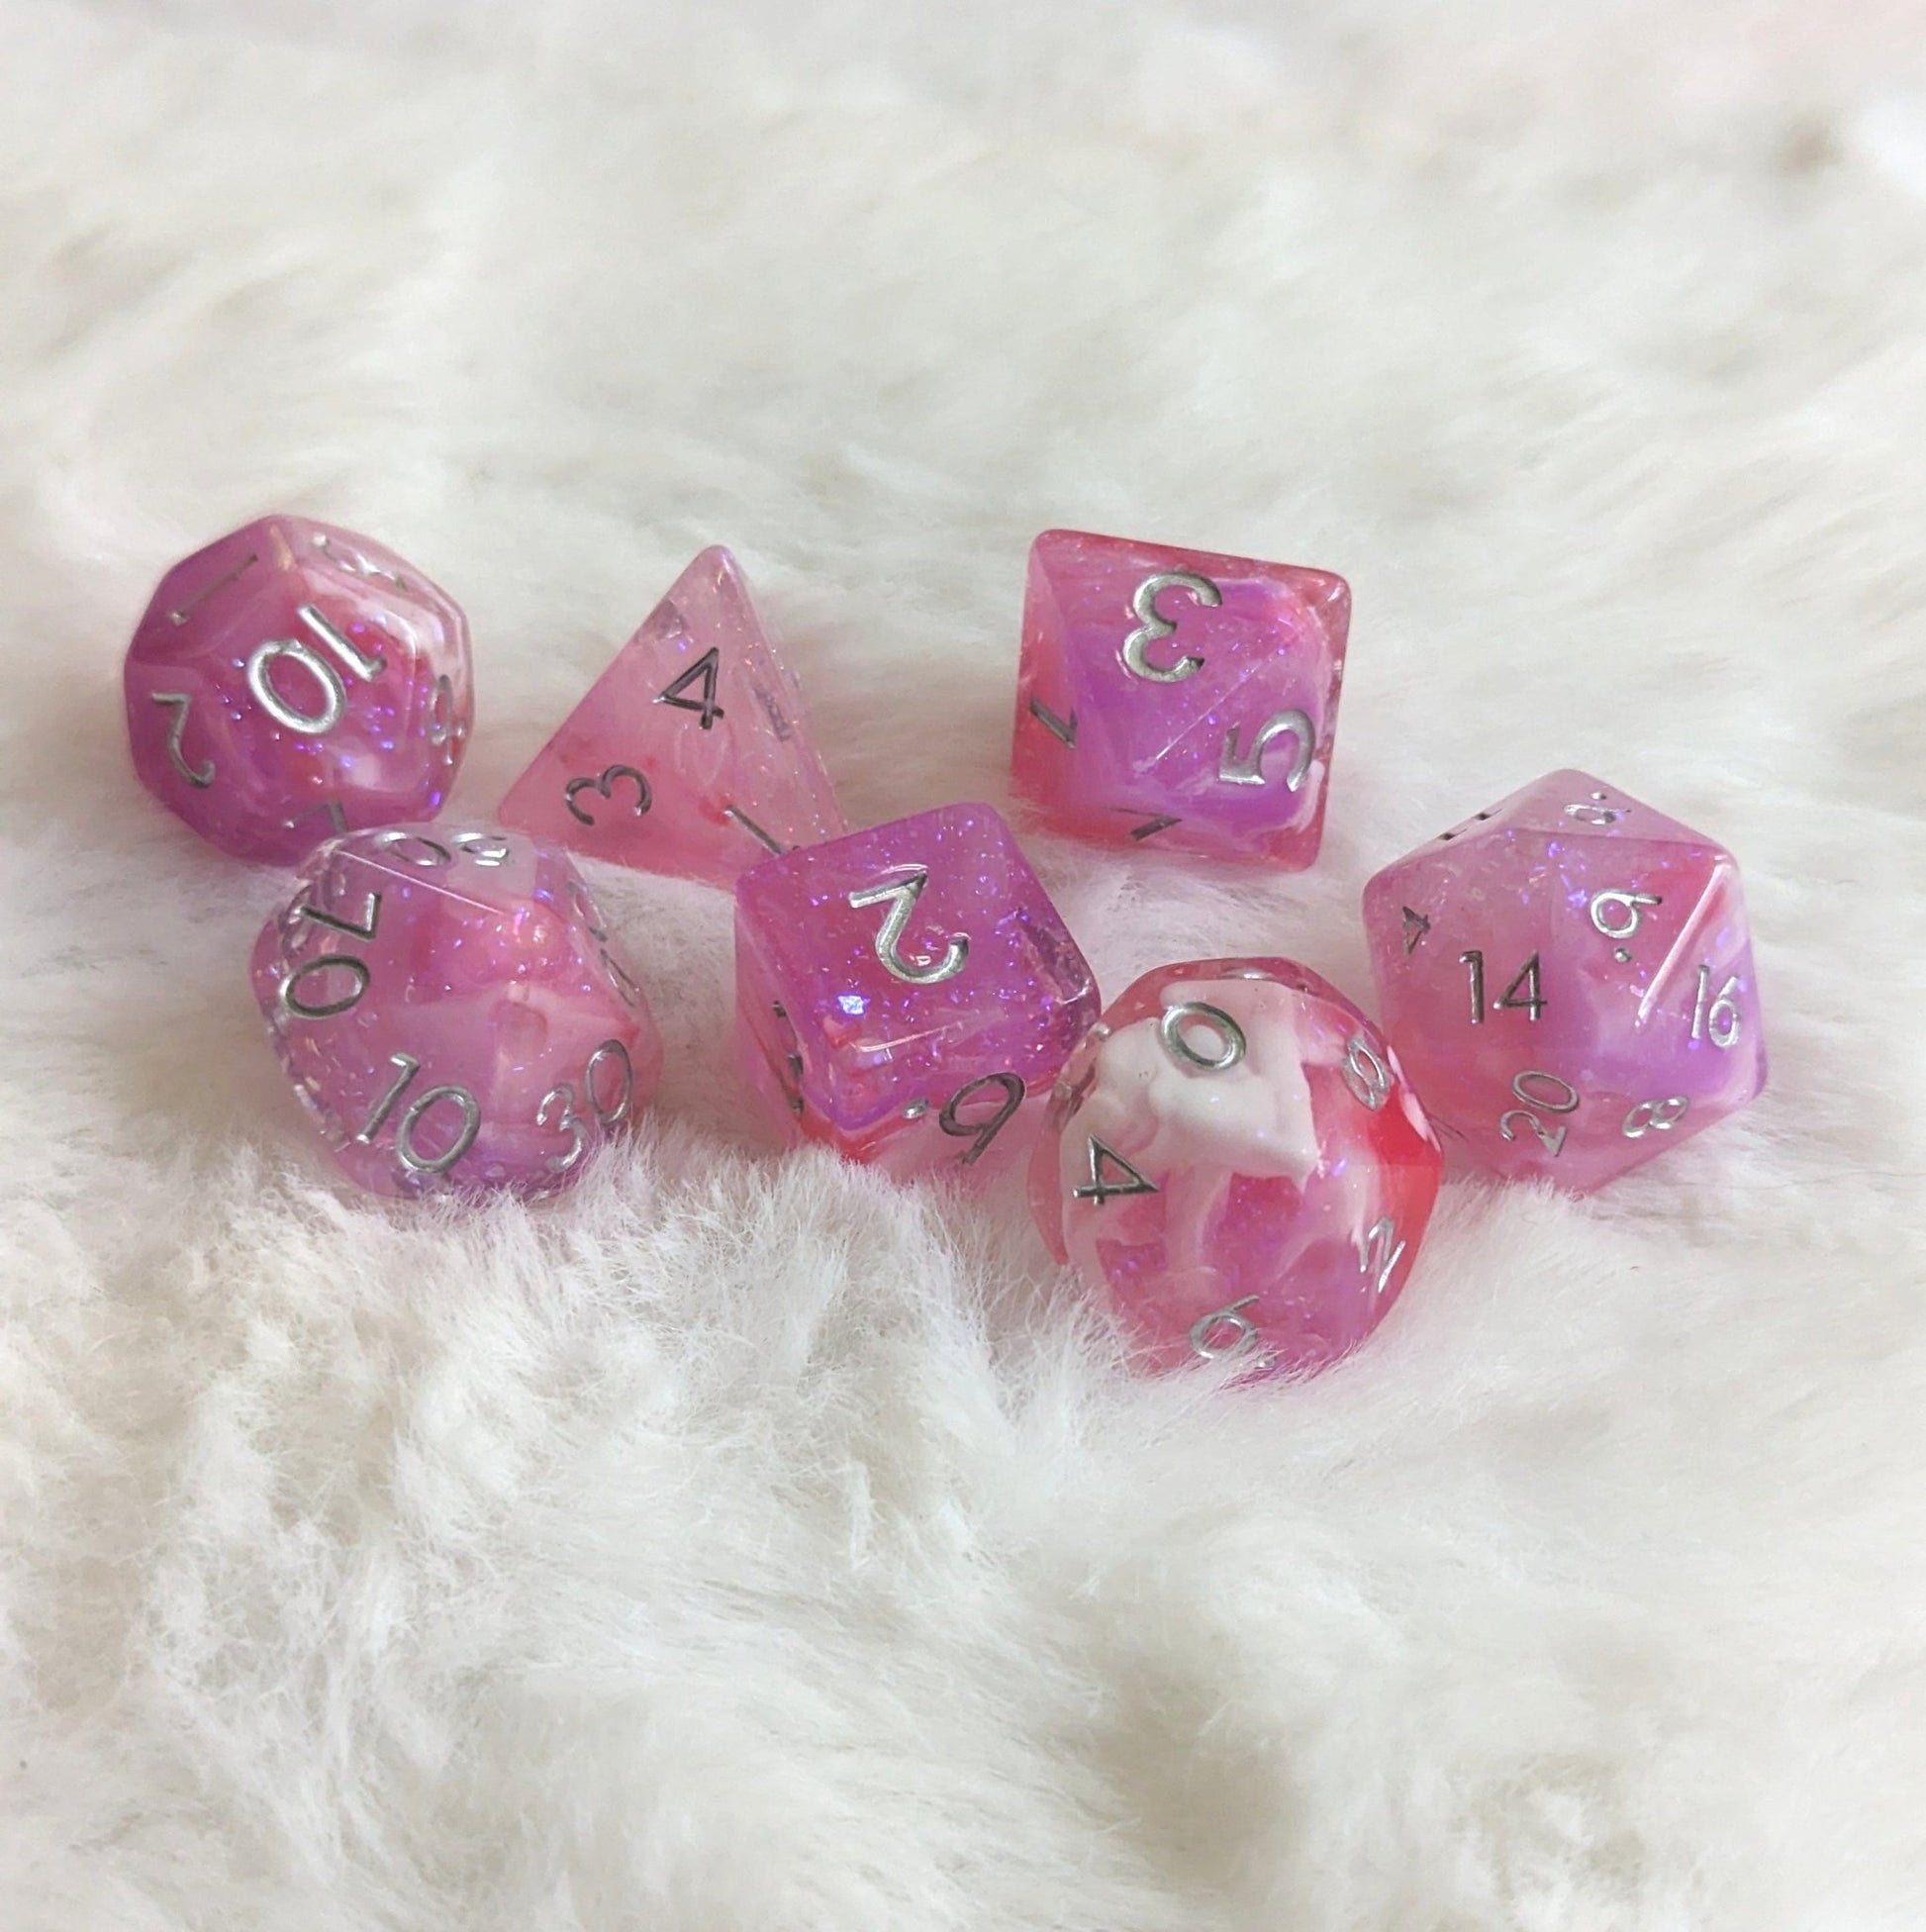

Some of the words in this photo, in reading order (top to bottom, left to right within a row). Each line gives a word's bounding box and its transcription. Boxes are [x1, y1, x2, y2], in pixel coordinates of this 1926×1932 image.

[170, 553, 259, 626] 1
[1123, 569, 1223, 685] 3
[248, 603, 387, 736] 10
[652, 646, 724, 730] 4
[150, 691, 217, 789] 2
[1218, 708, 1317, 793] 5
[564, 764, 652, 826] 3
[723, 805, 800, 857] 1
[279, 890, 382, 1020] 70
[847, 870, 969, 985] 2
[1399, 905, 1431, 961] 4
[1457, 948, 1549, 1025] 14
[1689, 962, 1743, 1049] 16
[1160, 1001, 1246, 1072] 0
[1342, 1035, 1392, 1111] 8
[356, 1052, 482, 1175] 10
[535, 1037, 633, 1173] 30
[1498, 1069, 1581, 1159] 20
[1620, 1095, 1690, 1140] 8
[1072, 1133, 1159, 1206] 4
[1359, 1214, 1407, 1295] 2
